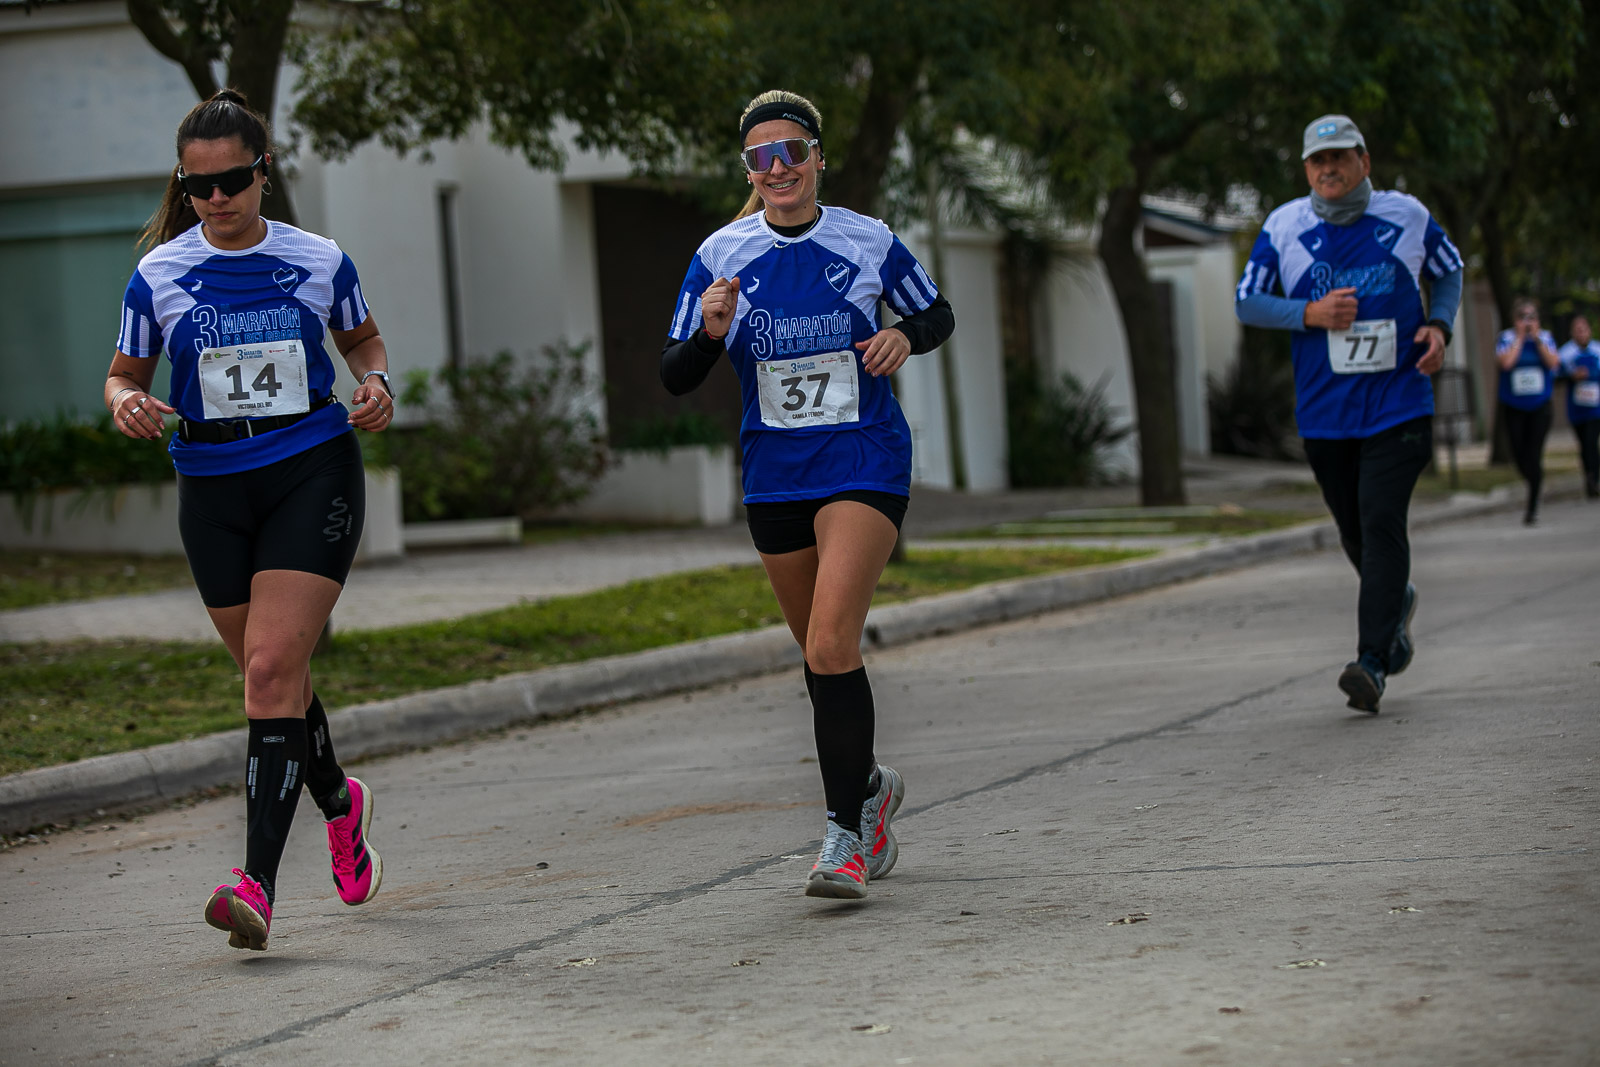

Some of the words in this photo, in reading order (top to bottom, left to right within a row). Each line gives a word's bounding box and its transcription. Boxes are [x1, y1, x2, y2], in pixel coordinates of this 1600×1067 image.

[1311, 261, 1332, 303] 3
[192, 305, 220, 354] 3
[220, 305, 300, 335] MARATÓN
[749, 309, 773, 360] 3
[774, 310, 851, 340] MARATÓN
[237, 349, 244, 360] 3
[1345, 335, 1379, 361] 77
[225, 362, 282, 401] 14
[791, 363, 797, 373] 3
[780, 372, 831, 411] 37
